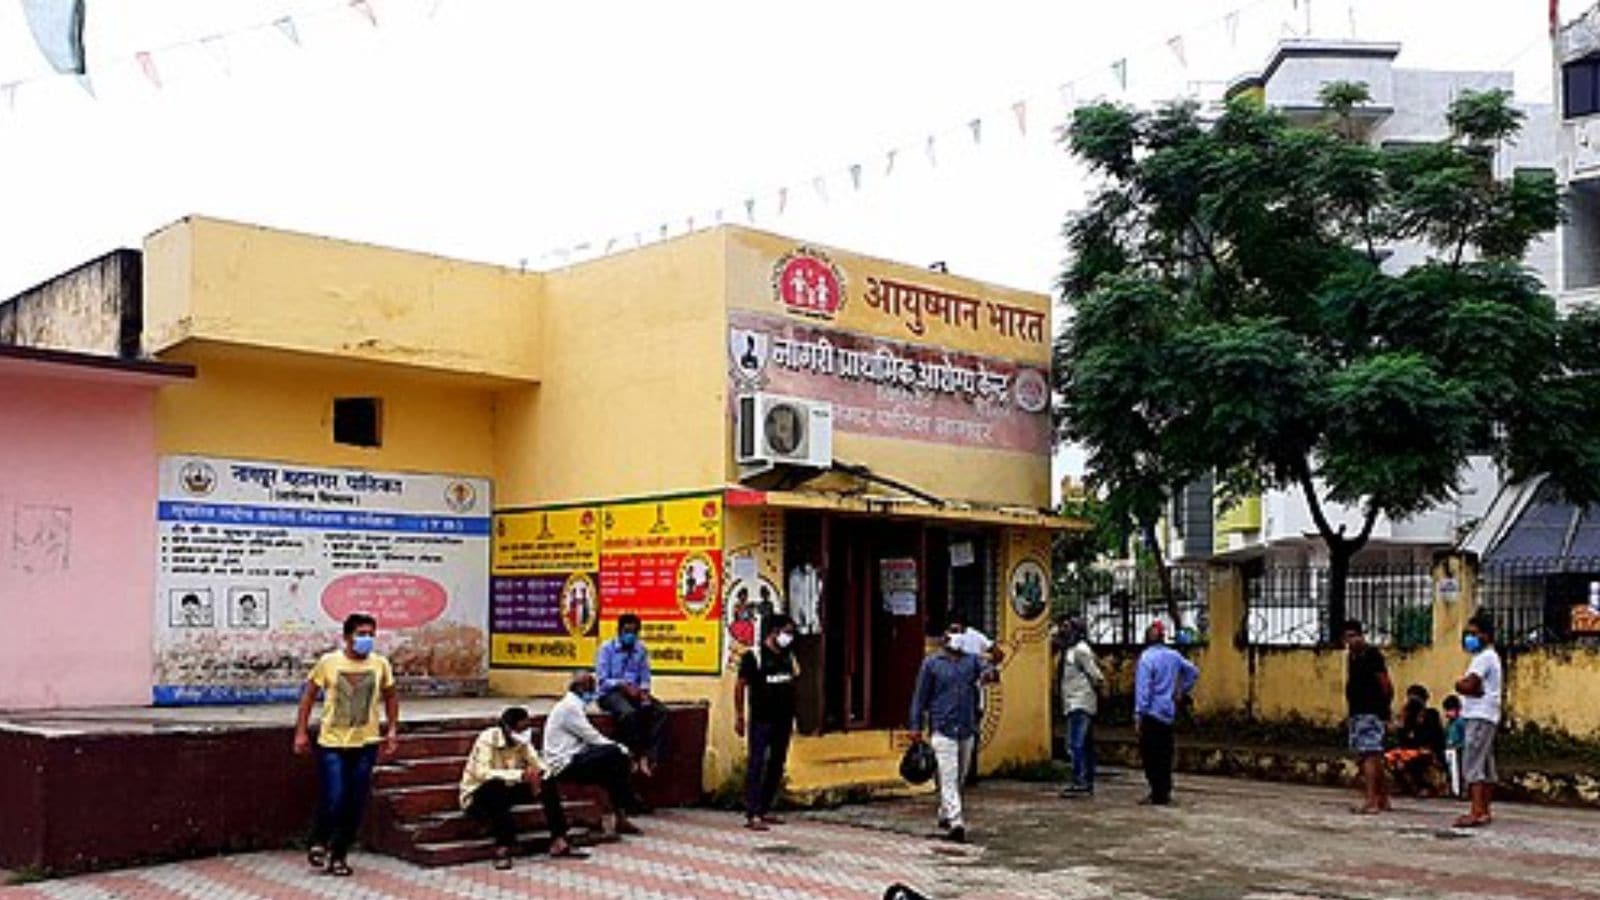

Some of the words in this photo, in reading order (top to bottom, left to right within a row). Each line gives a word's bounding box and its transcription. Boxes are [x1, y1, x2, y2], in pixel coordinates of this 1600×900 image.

[863, 276, 980, 336] आयुष्मान
[986, 301, 1046, 342] भारत
[773, 337, 833, 374] नागरी
[838, 347, 917, 385] प्राथमिक
